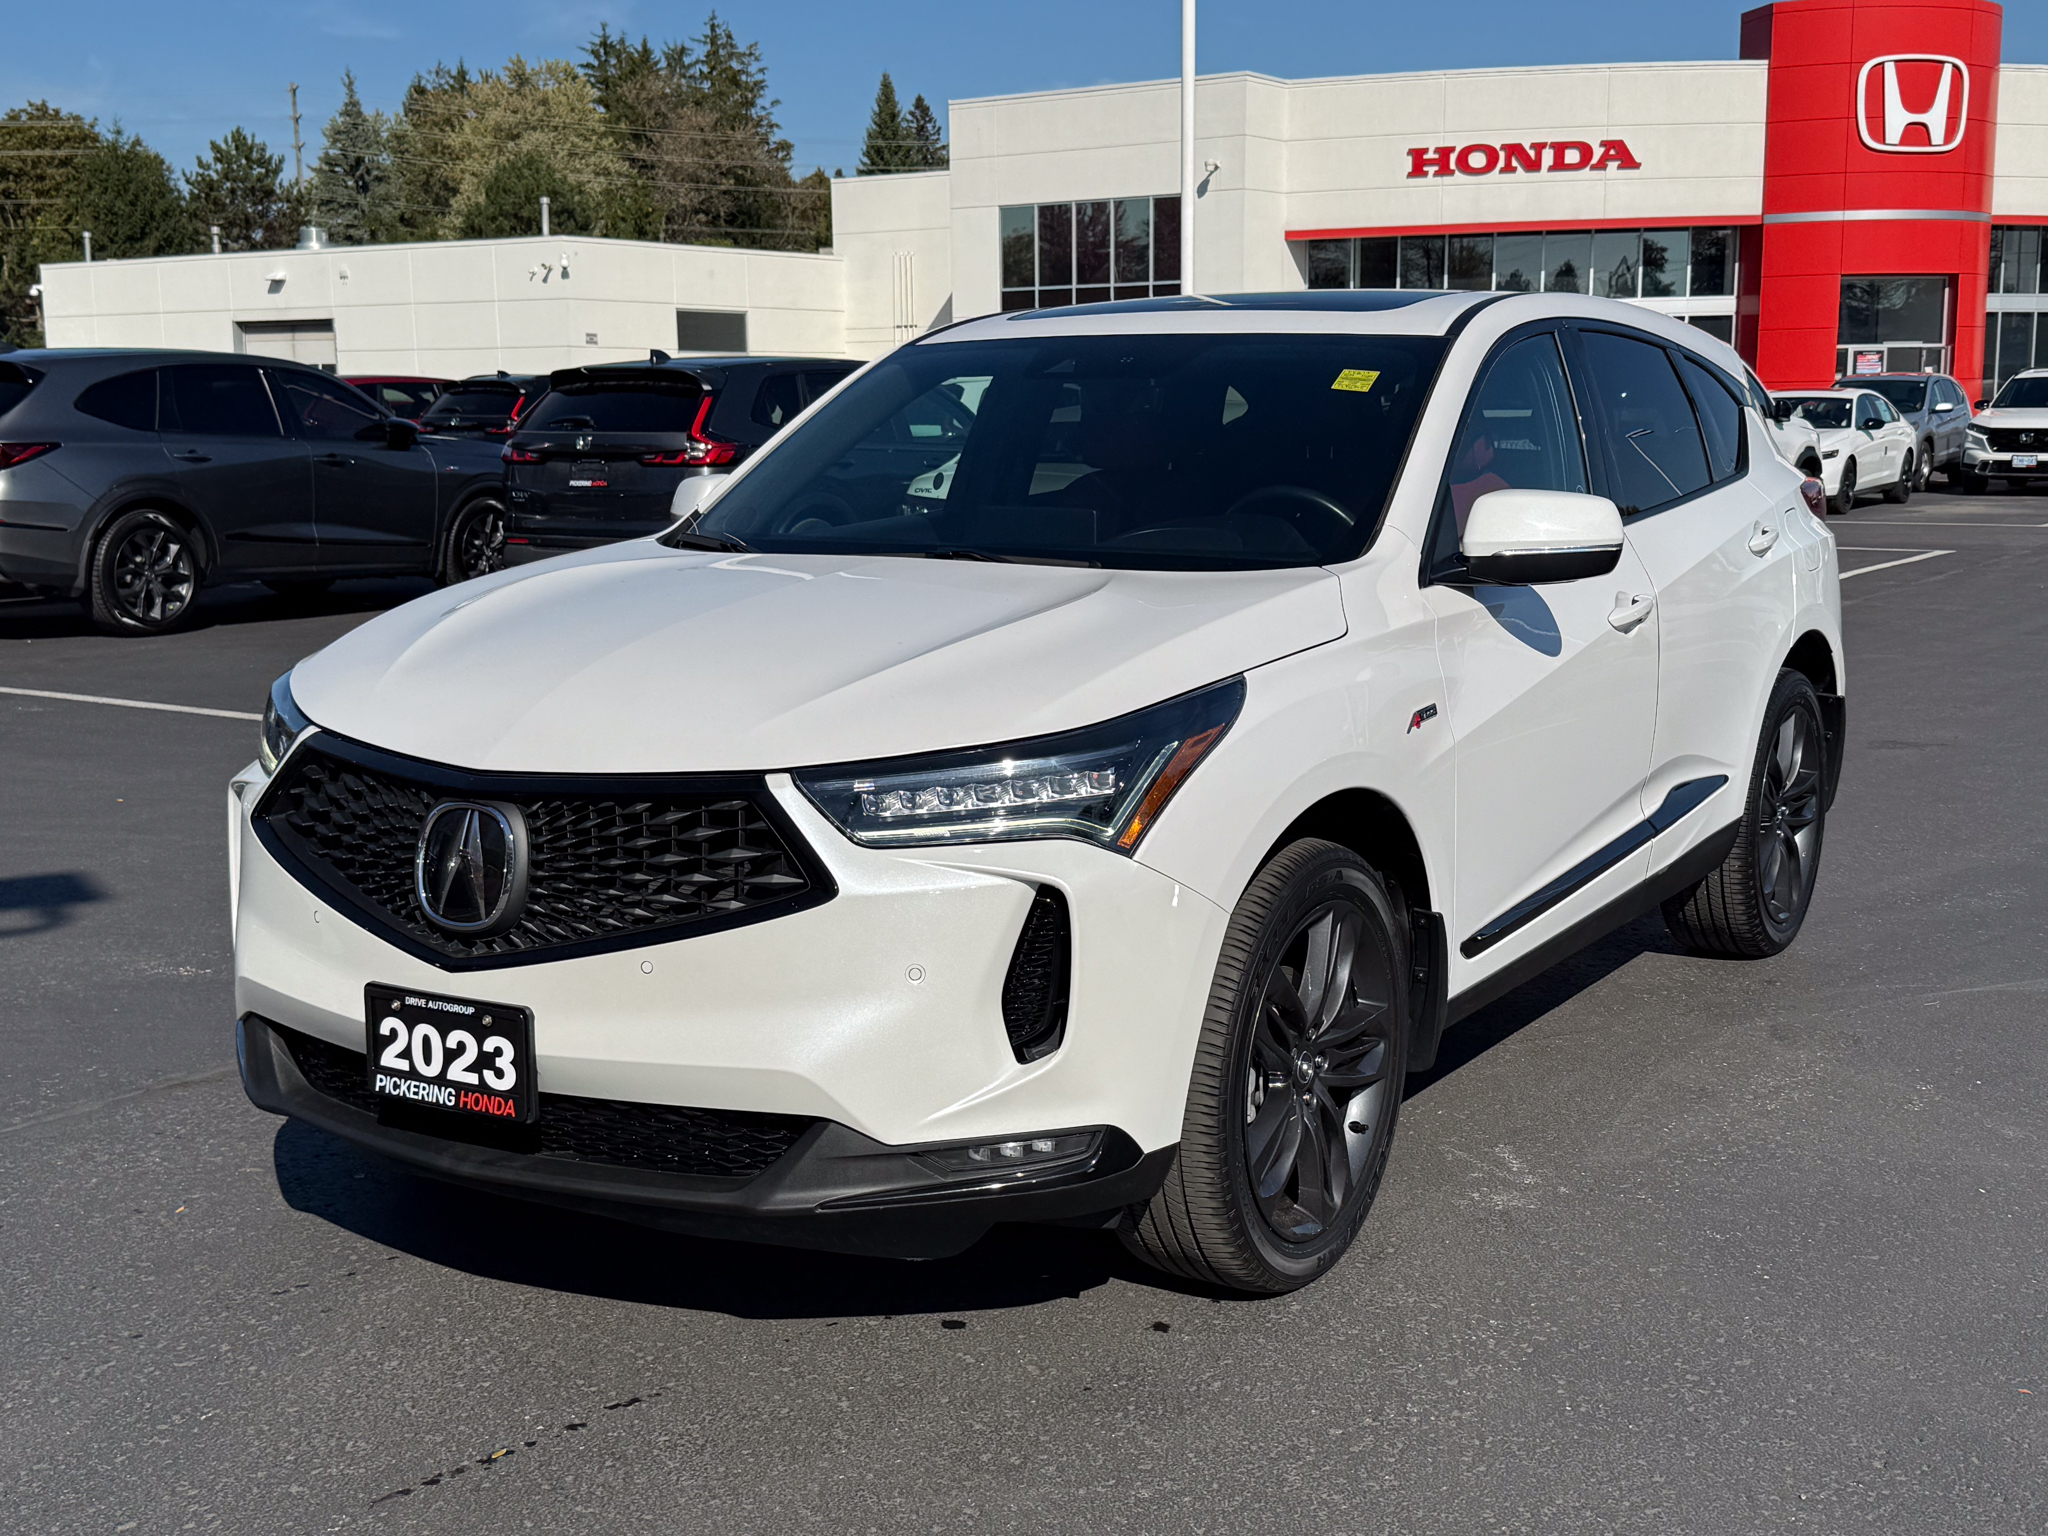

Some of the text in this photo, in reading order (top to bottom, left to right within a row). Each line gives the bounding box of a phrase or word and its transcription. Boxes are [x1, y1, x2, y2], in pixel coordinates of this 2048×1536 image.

[1406, 139, 1642, 179] HONDA
[405, 996, 475, 1015] DRIVE AUTOGROUP
[379, 1017, 517, 1091] 2023
[375, 1074, 516, 1118] PICKERING HONDA
